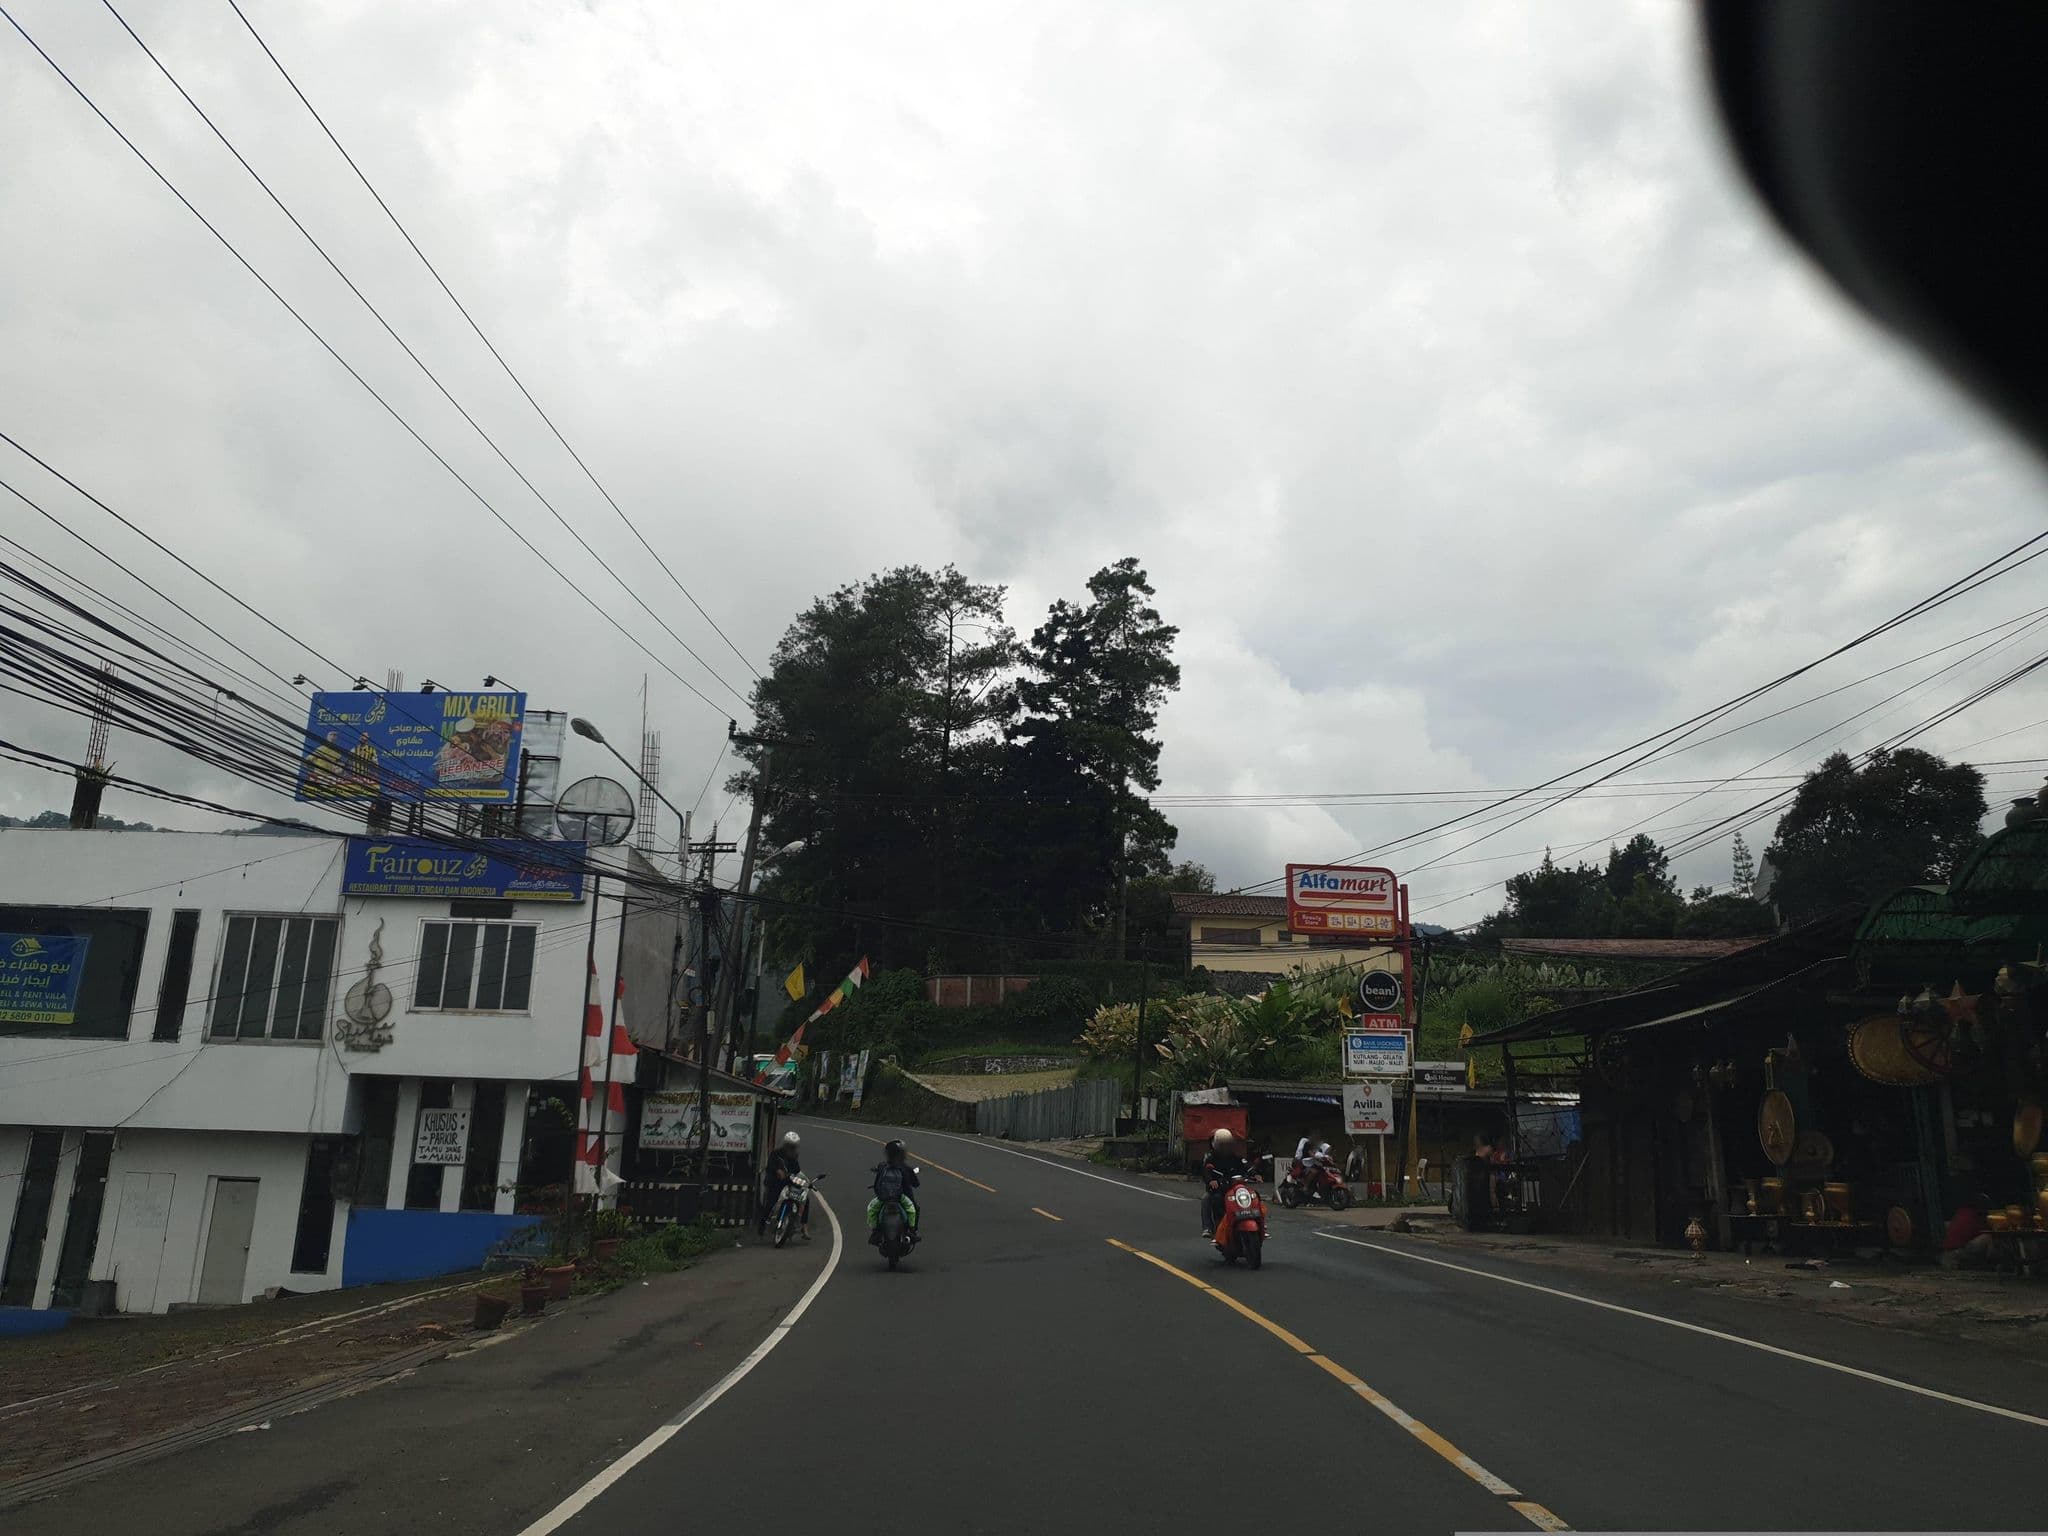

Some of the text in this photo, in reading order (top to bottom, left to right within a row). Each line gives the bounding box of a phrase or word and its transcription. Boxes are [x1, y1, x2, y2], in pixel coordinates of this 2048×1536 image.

[443, 696, 519, 717] MIX GRILL
[438, 758, 504, 776] LEBANESE
[364, 843, 463, 876] Fairouz
[1298, 873, 1387, 892] Alfamart
[44, 992, 66, 1000] VILLA
[1365, 984, 1395, 996] bean!
[34, 1013, 56, 1022] 0101
[1368, 1018, 1398, 1028] ATM
[1353, 1099, 1383, 1109] Avilla
[424, 1112, 458, 1132] KHUSUS
[429, 1132, 458, 1145] PARKIR
